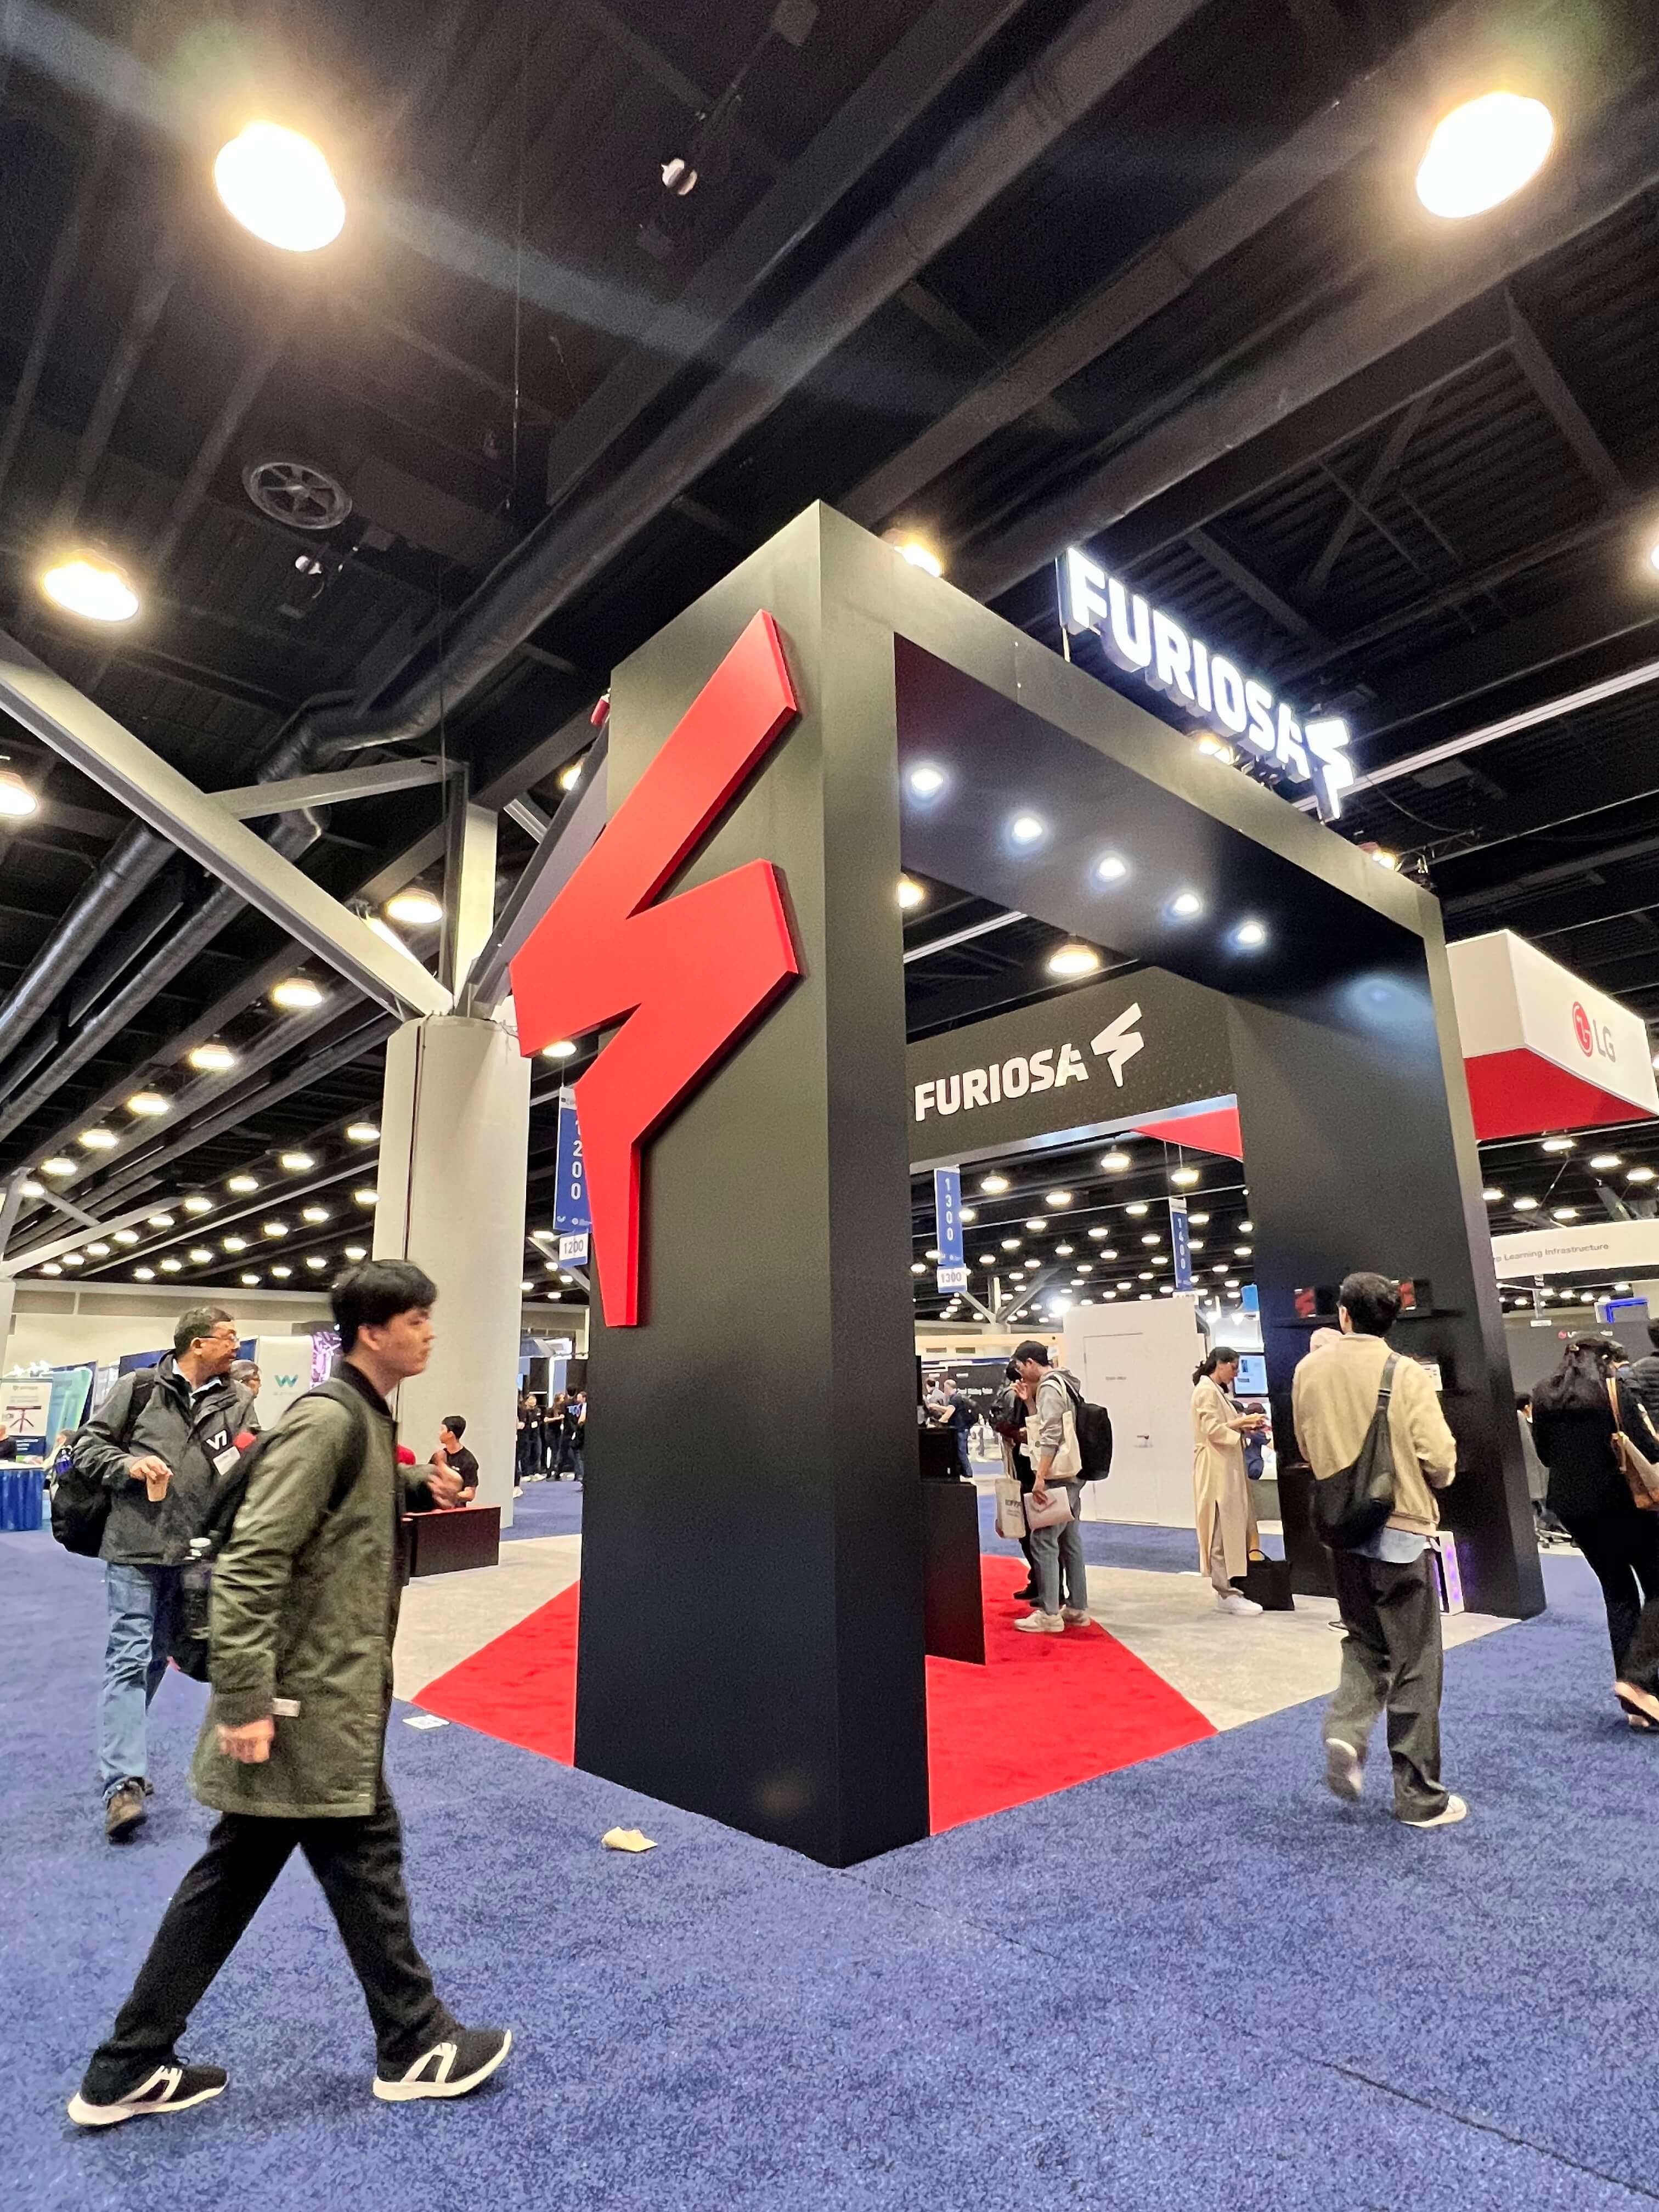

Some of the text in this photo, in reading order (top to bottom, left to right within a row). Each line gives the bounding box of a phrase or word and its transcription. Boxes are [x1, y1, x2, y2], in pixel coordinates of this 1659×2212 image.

[1067, 548, 1311, 780] FURIOSA
[1592, 1019, 1616, 1063] LG
[915, 1043, 1089, 1122] FURIOSA
[571, 1119, 583, 1200] 1200
[945, 1178, 954, 1241] 1300
[563, 1240, 584, 1255] 1200
[1504, 1250, 1543, 1261] Learning
[1545, 1243, 1609, 1255] Infrastructure
[940, 1272, 962, 1283] 1300
